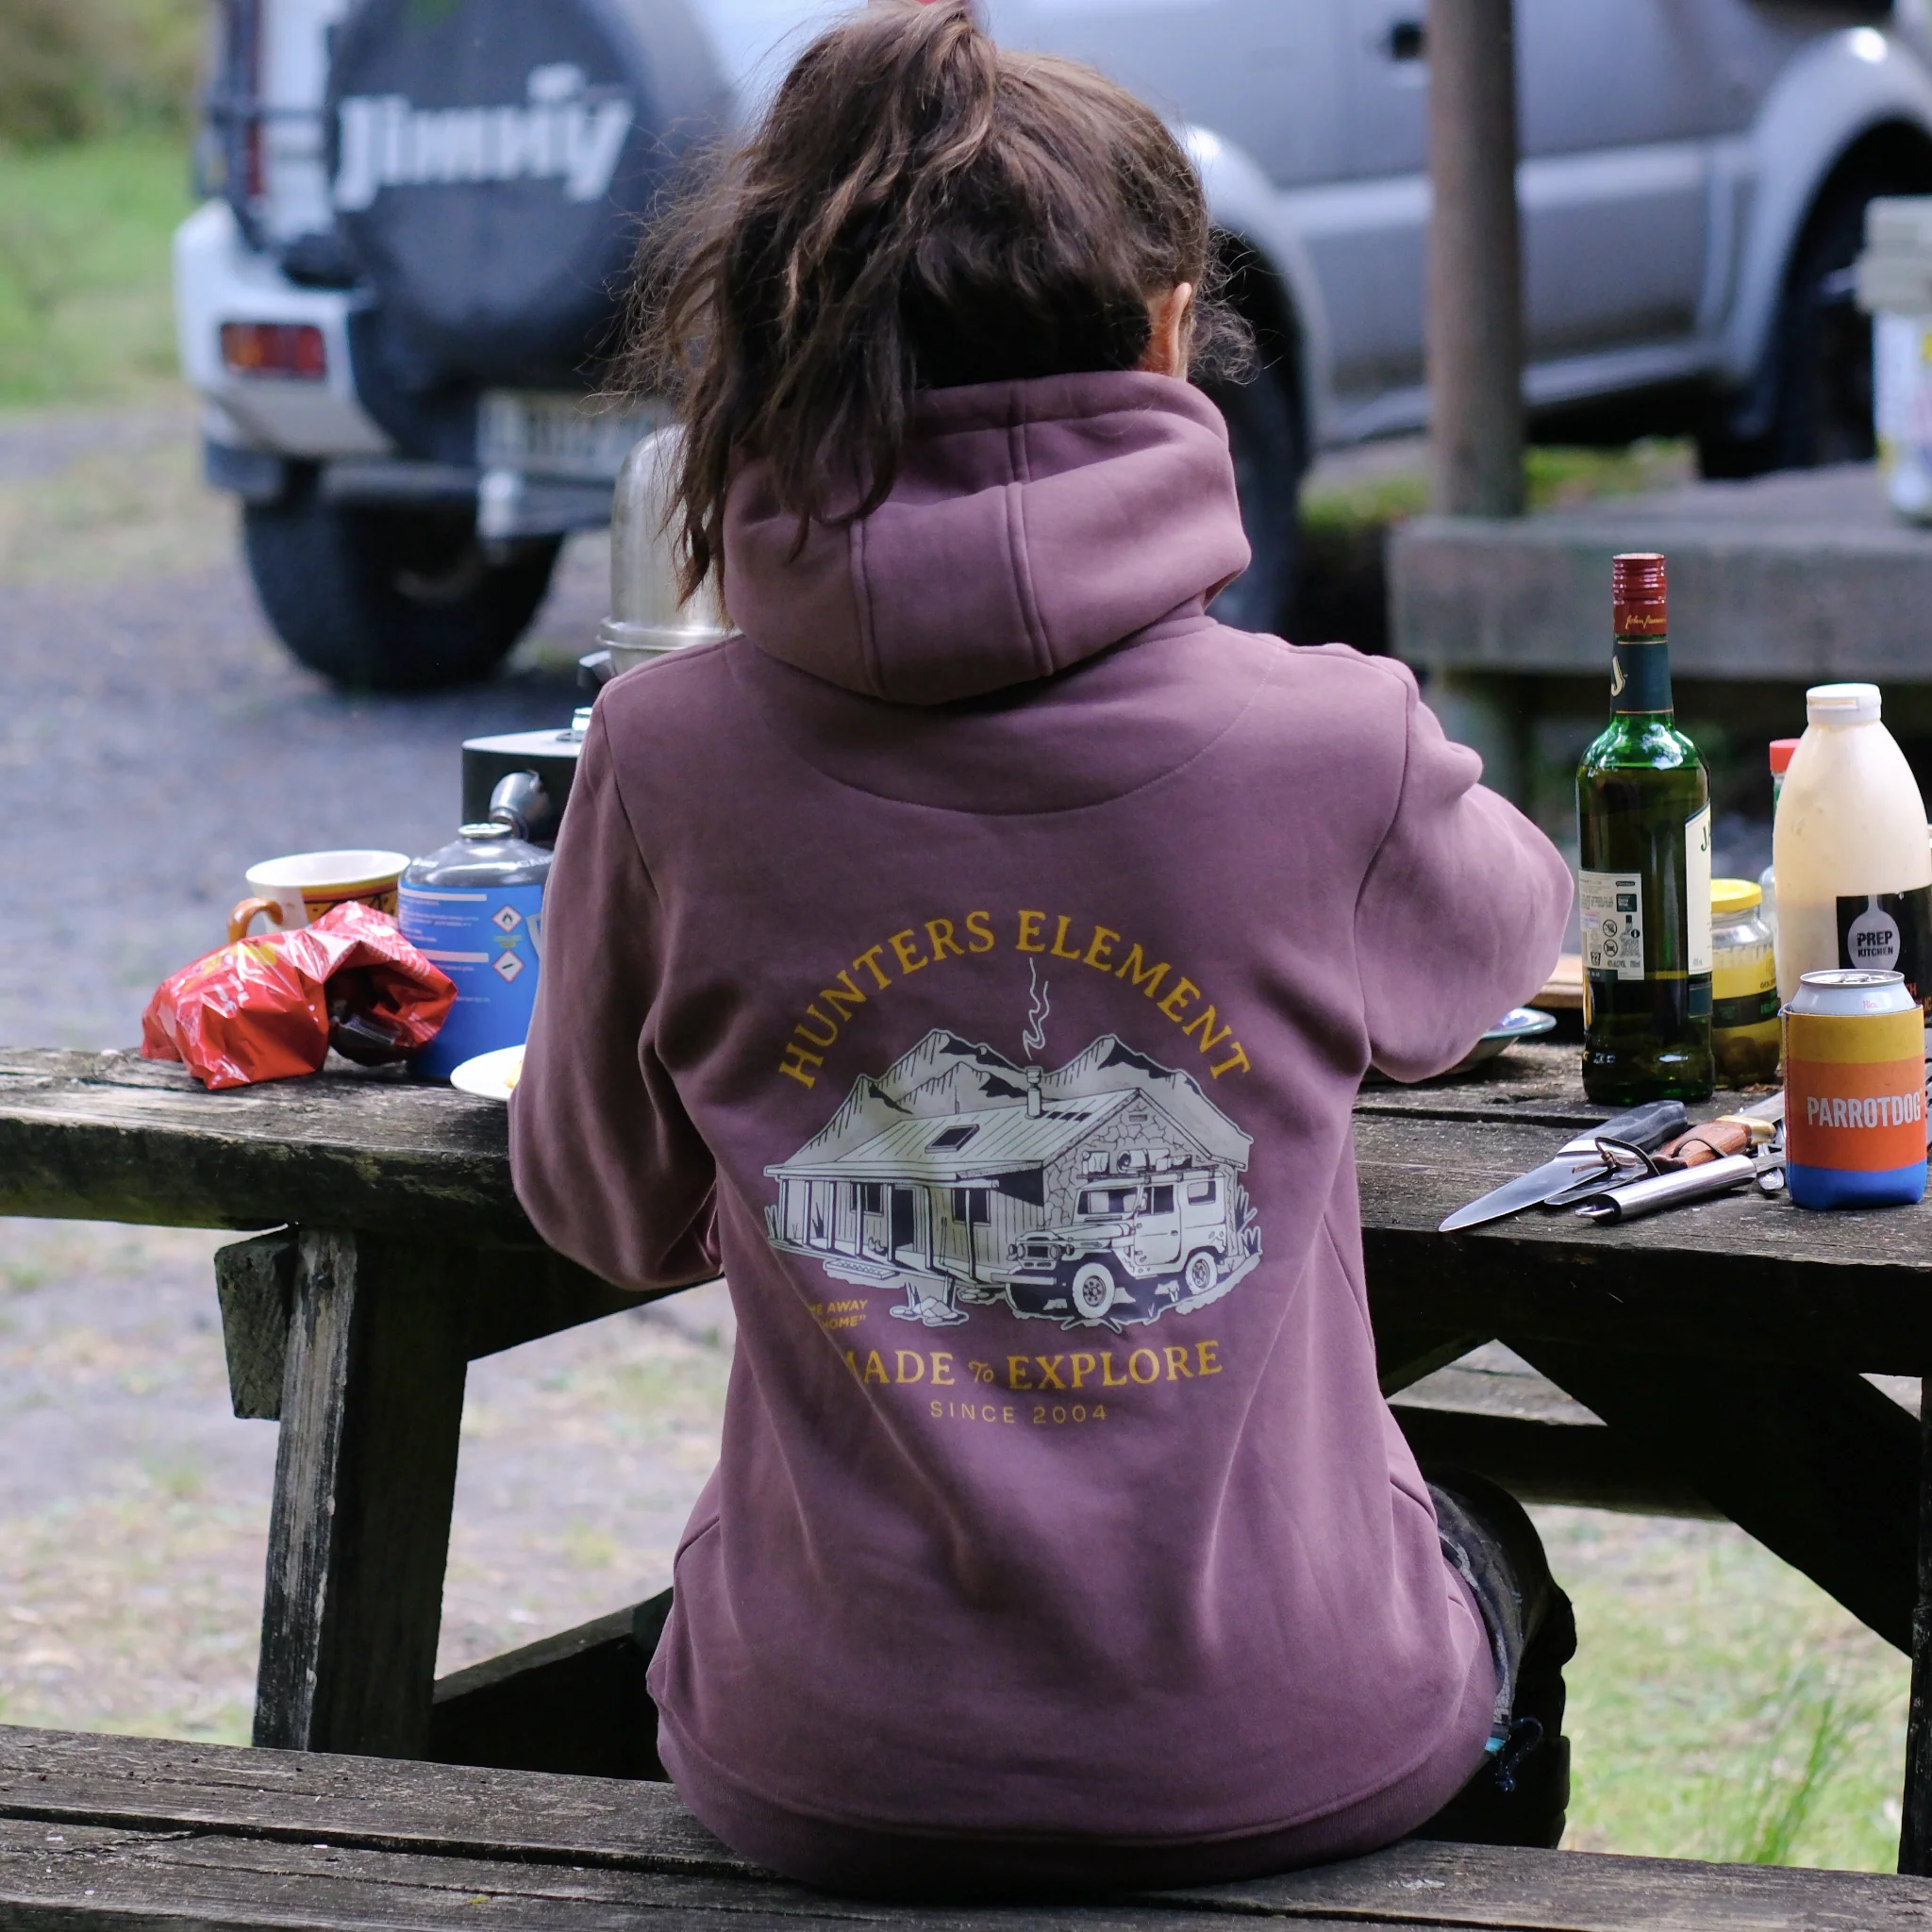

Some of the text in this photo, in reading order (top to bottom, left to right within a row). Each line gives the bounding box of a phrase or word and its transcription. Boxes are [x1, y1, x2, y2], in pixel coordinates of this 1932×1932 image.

[332, 92, 636, 210] Jimny
[1857, 930, 1893, 946] PREP
[1857, 946, 1893, 958] KITCHEN
[778, 909, 1251, 1091] HUNTERS ELEMENT
[1807, 1091, 1921, 1128] PARROTDOG
[826, 1299, 868, 1313] AWAY
[1007, 1340, 1223, 1391] EXPLORE
[930, 1400, 1107, 1424] SINCE 2004
